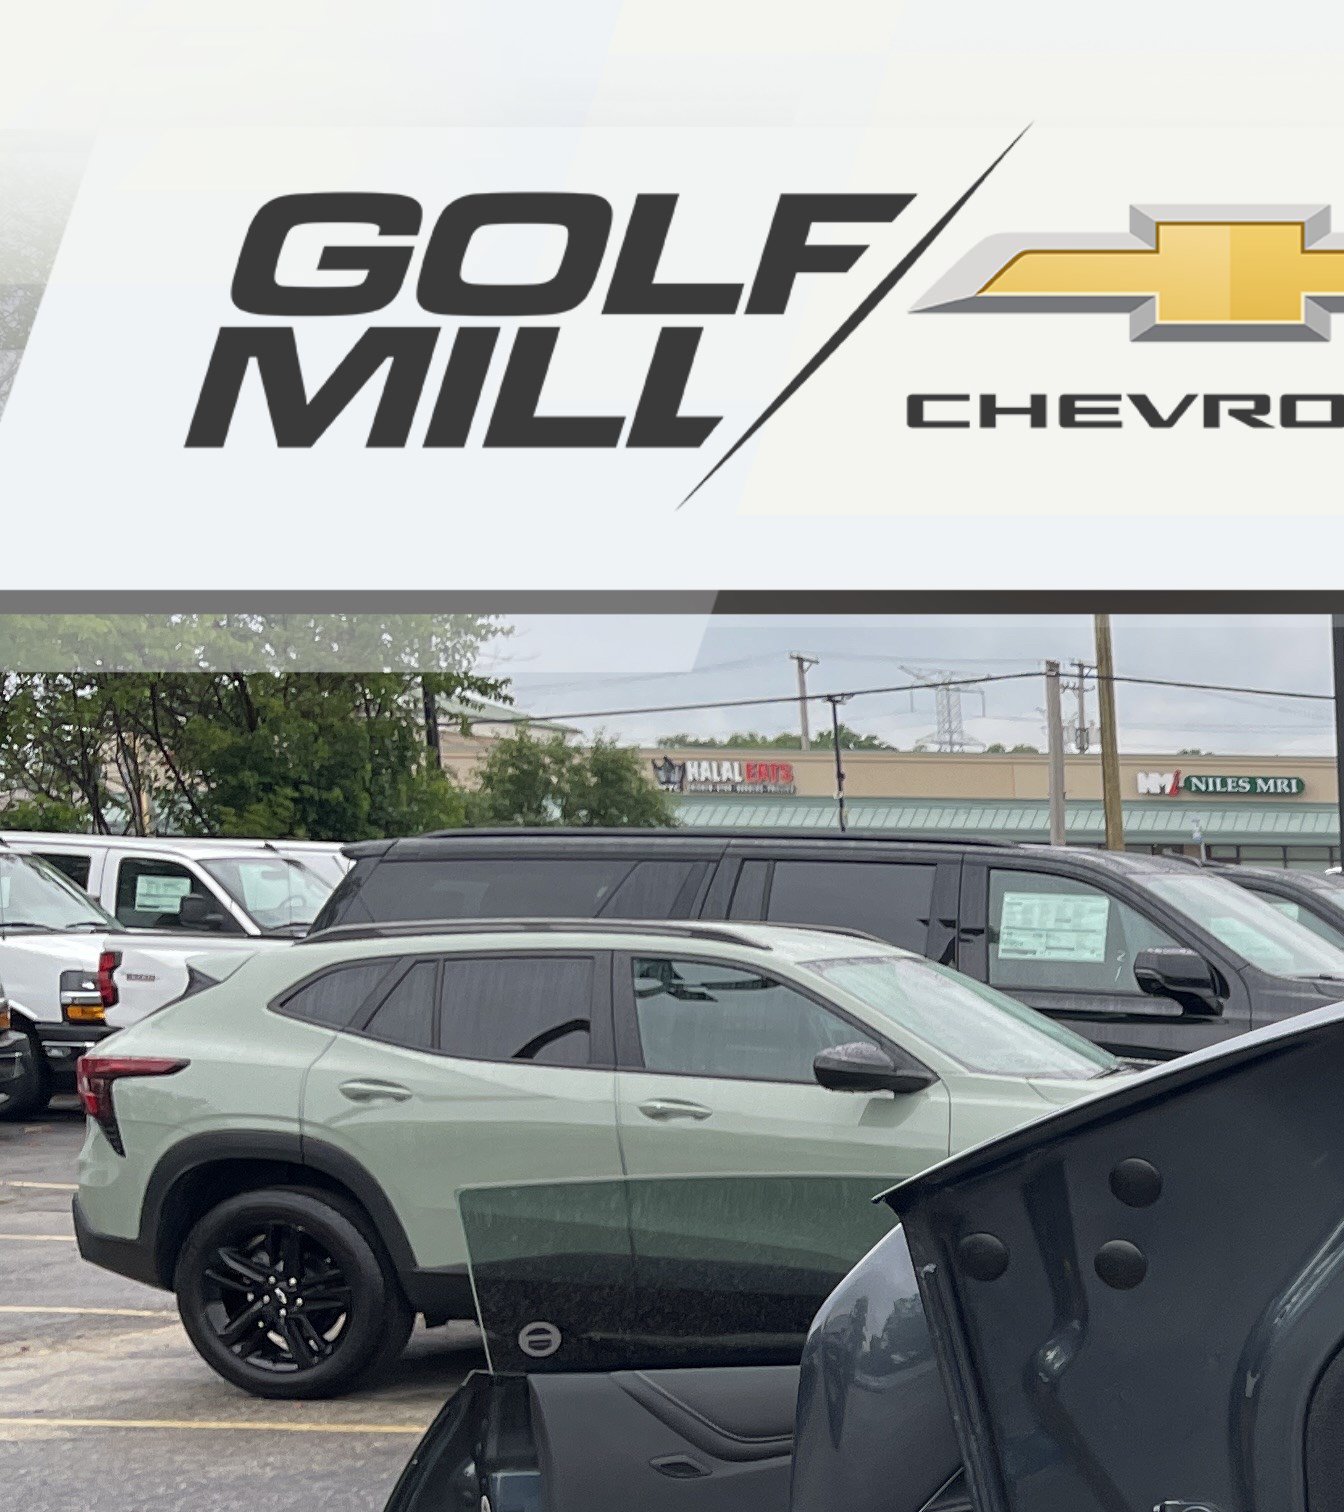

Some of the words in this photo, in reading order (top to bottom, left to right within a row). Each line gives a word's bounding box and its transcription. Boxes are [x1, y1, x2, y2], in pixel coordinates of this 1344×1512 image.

[686, 760, 742, 783] HALAL
[745, 762, 794, 783] EATS
[1190, 776, 1250, 793] NILES
[1256, 778, 1298, 793] MRI
